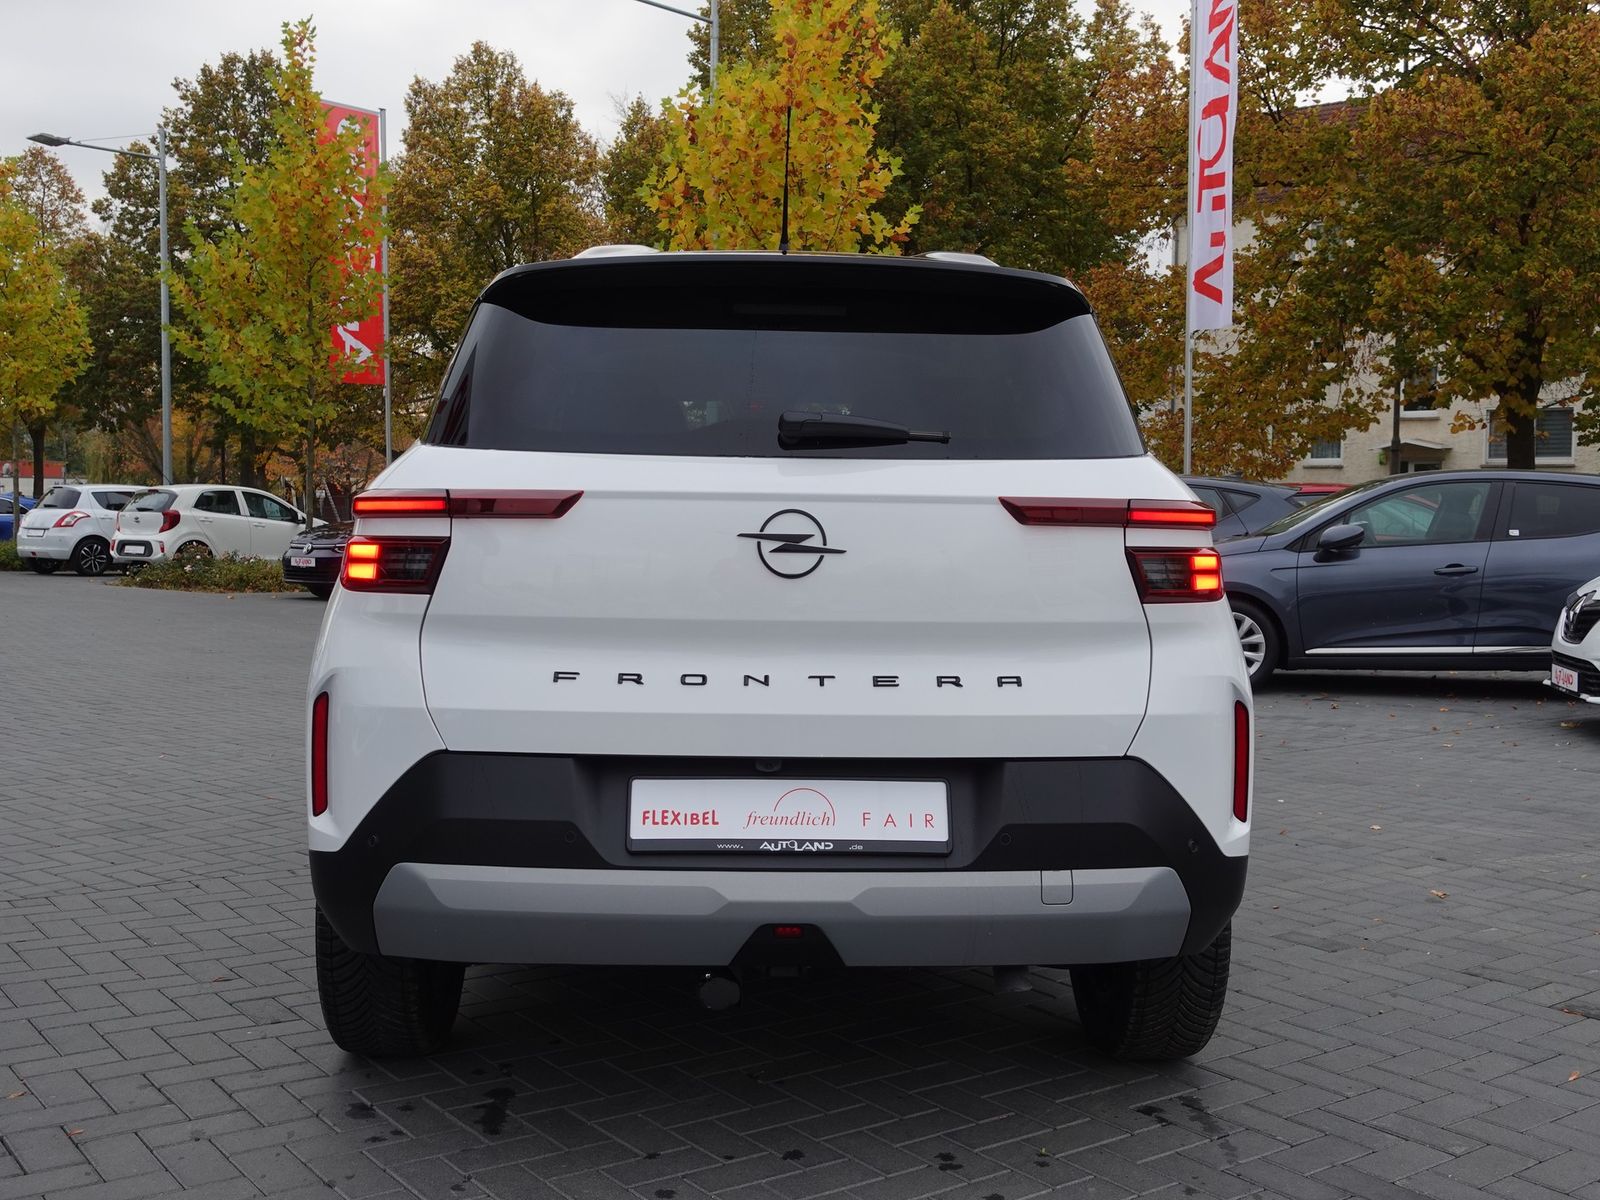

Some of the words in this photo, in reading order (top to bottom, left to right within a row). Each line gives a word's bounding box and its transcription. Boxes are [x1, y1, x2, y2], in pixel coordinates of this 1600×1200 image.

[552, 671, 1023, 688] FRONTERA
[642, 809, 719, 826] FLEXIBEL
[742, 810, 831, 830] freundlich
[862, 812, 935, 829] FAIR
[760, 840, 834, 852] AUTOLAND
